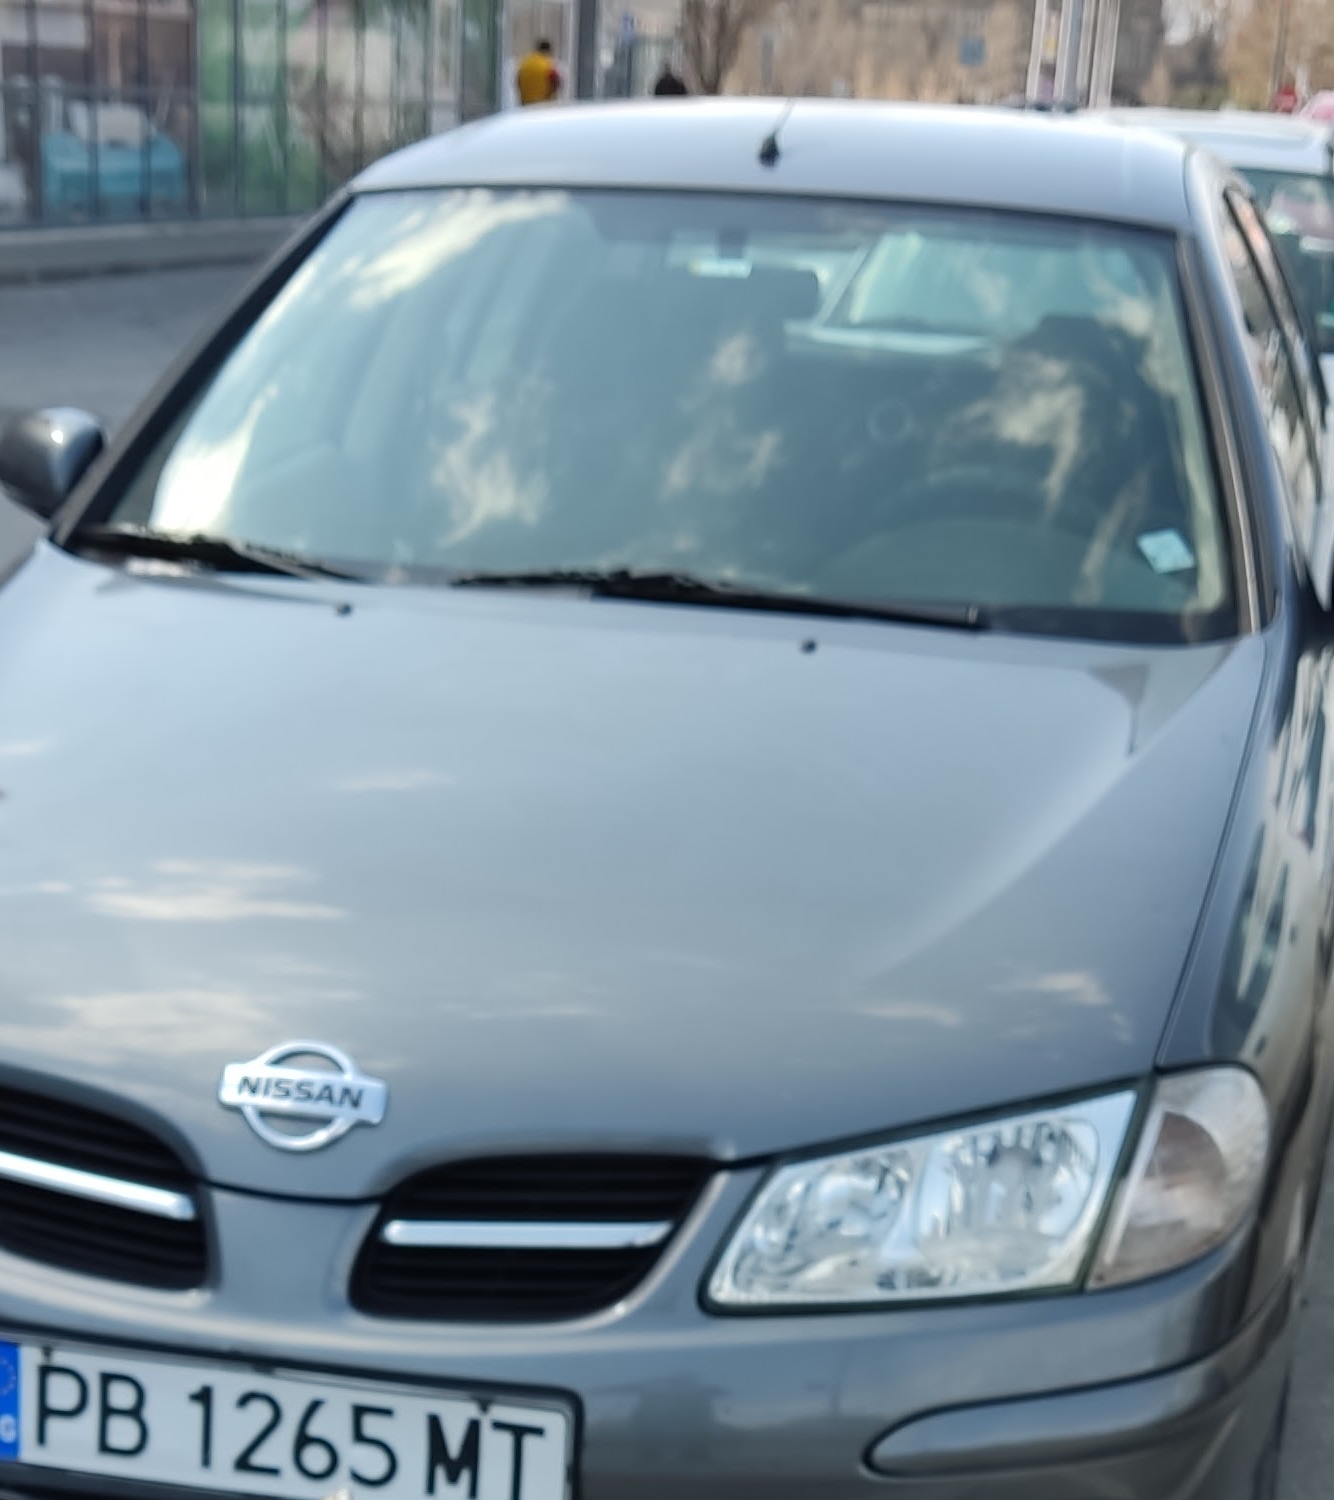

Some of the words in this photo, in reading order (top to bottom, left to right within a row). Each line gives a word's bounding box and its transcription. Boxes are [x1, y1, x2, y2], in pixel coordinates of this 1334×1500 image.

[238, 1076, 364, 1109] NISSAN
[36, 1364, 149, 1456] PB
[188, 1385, 398, 1487] 1265
